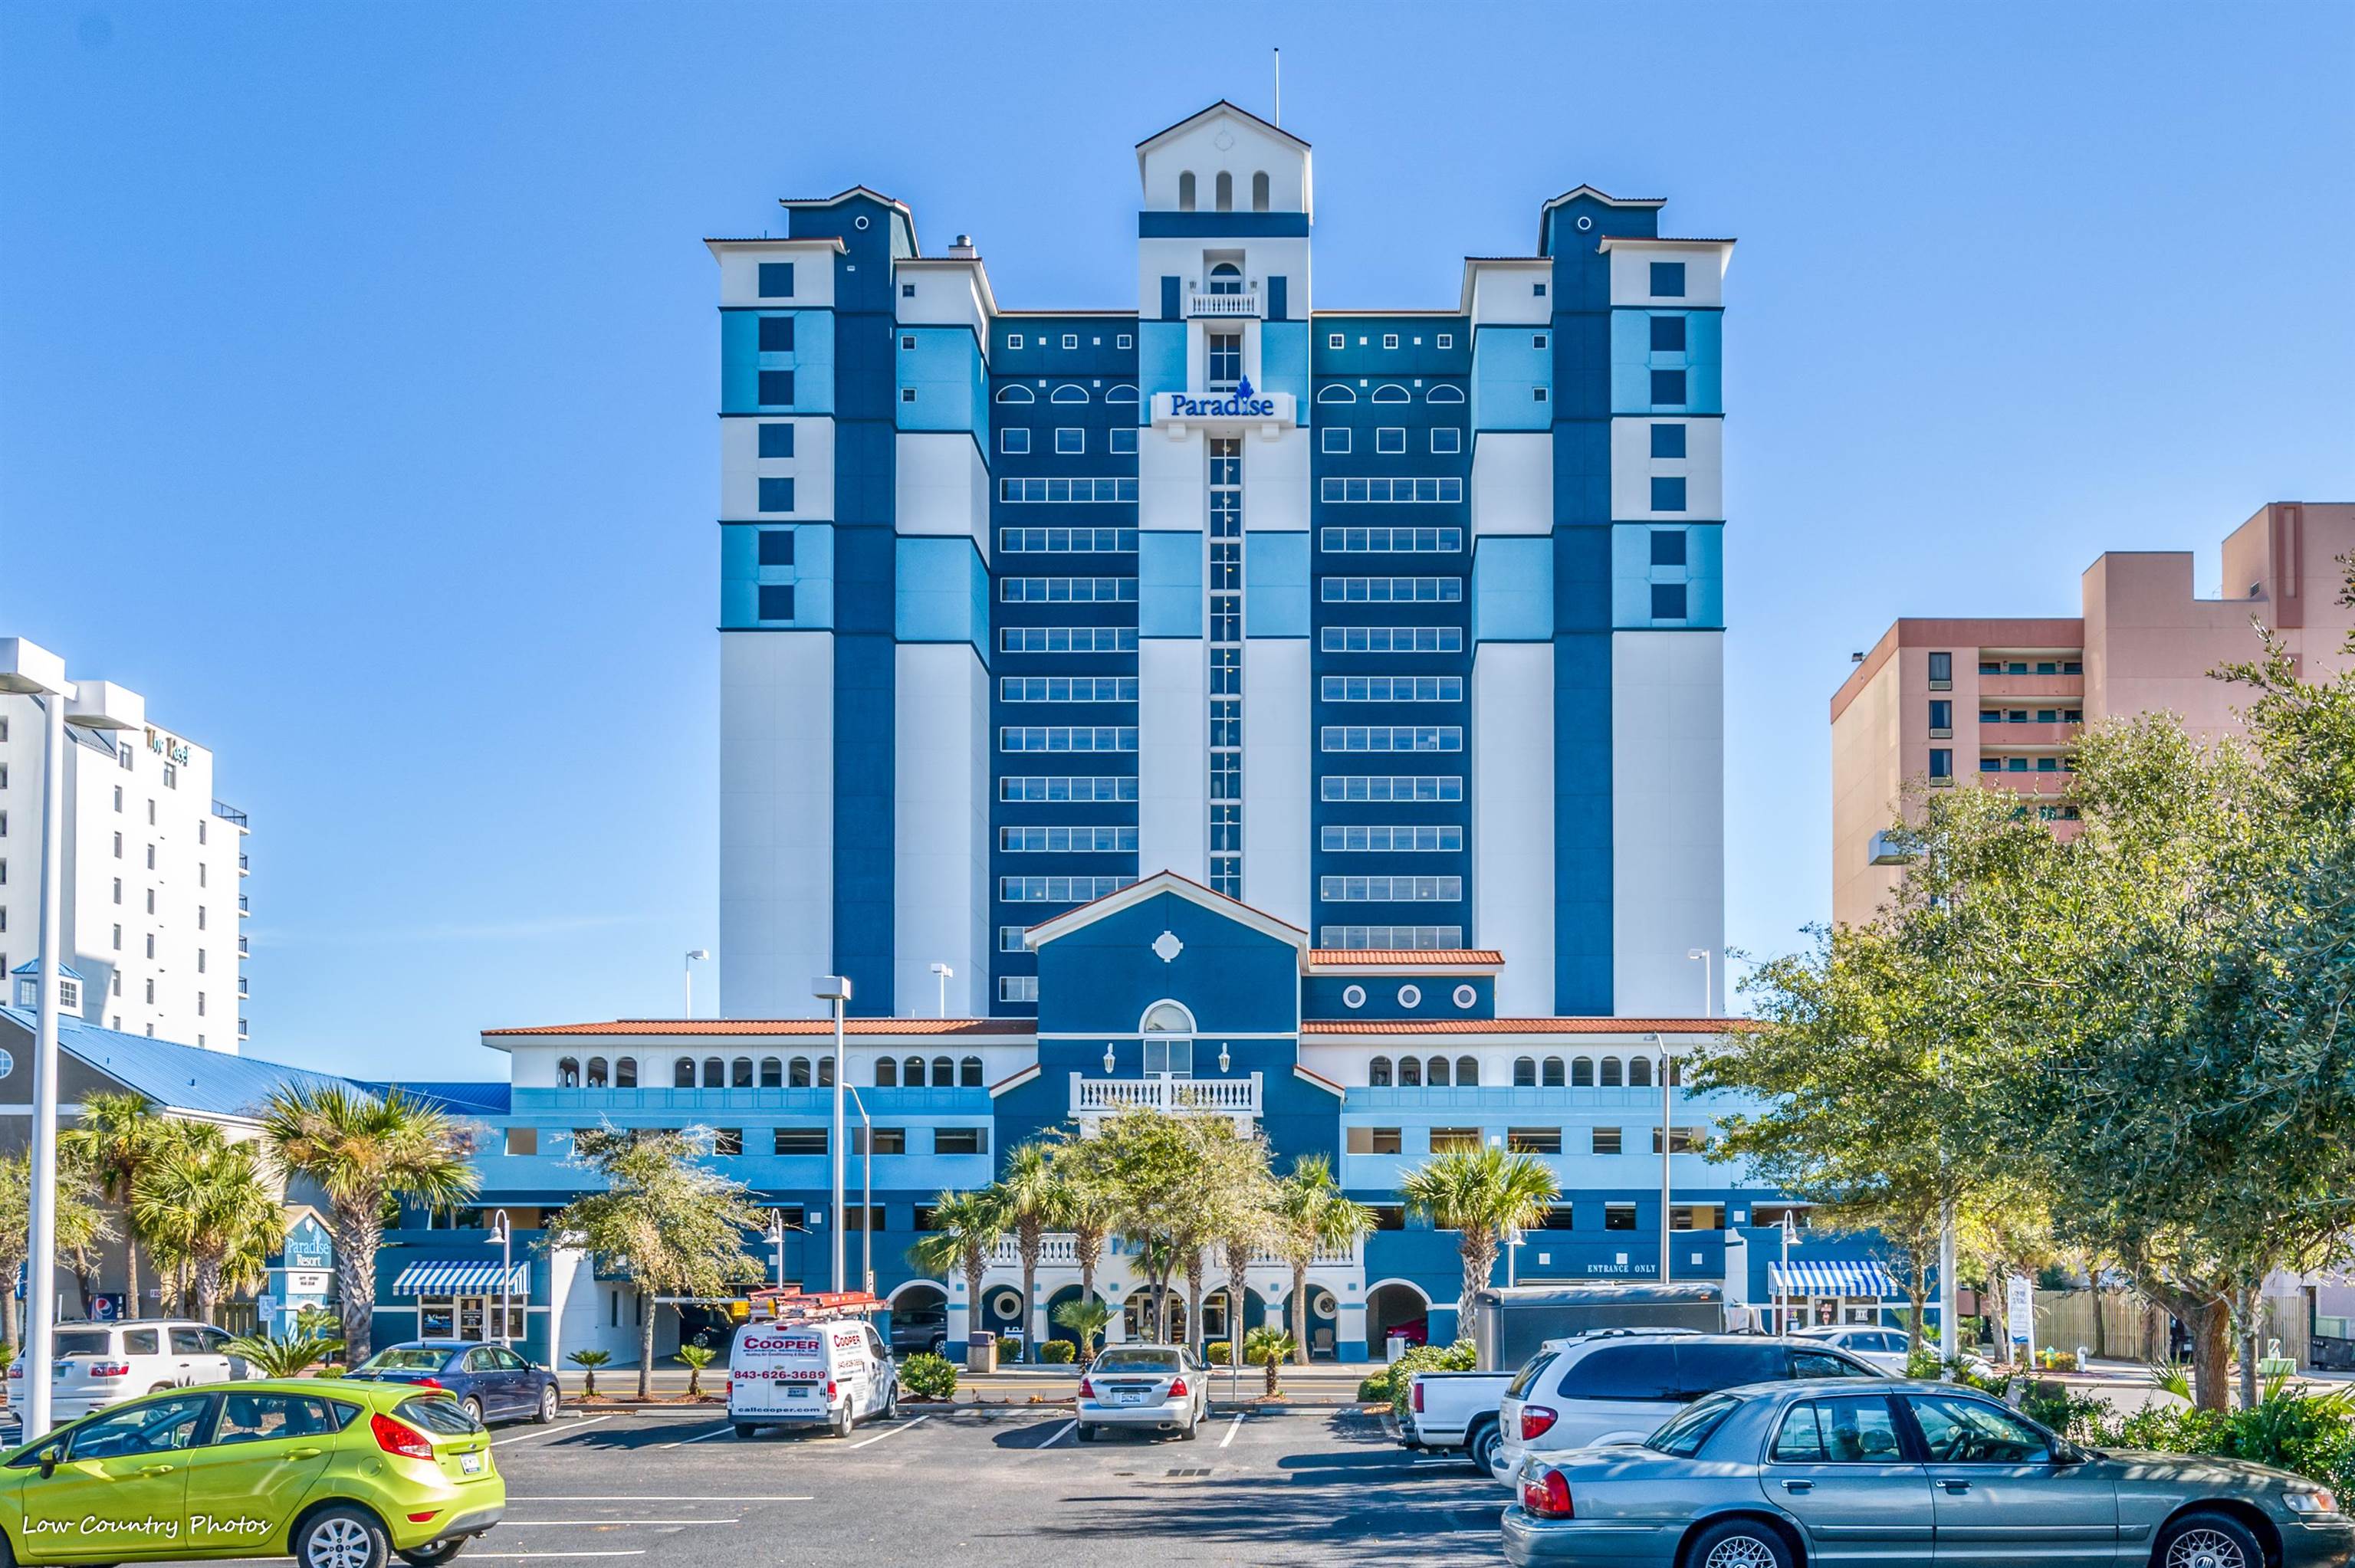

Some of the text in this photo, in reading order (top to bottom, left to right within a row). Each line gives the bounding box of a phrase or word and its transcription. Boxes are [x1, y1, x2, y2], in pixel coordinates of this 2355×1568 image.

[1171, 391, 1274, 416] Paradise
[287, 1234, 330, 1255] Paradise
[296, 1253, 322, 1267] Resort
[1588, 1264, 1656, 1273] ENTRANCE ONLY
[744, 1337, 819, 1350] COOPER
[734, 1370, 826, 1379] 843-626-3689
[819, 1386, 826, 1398] 44
